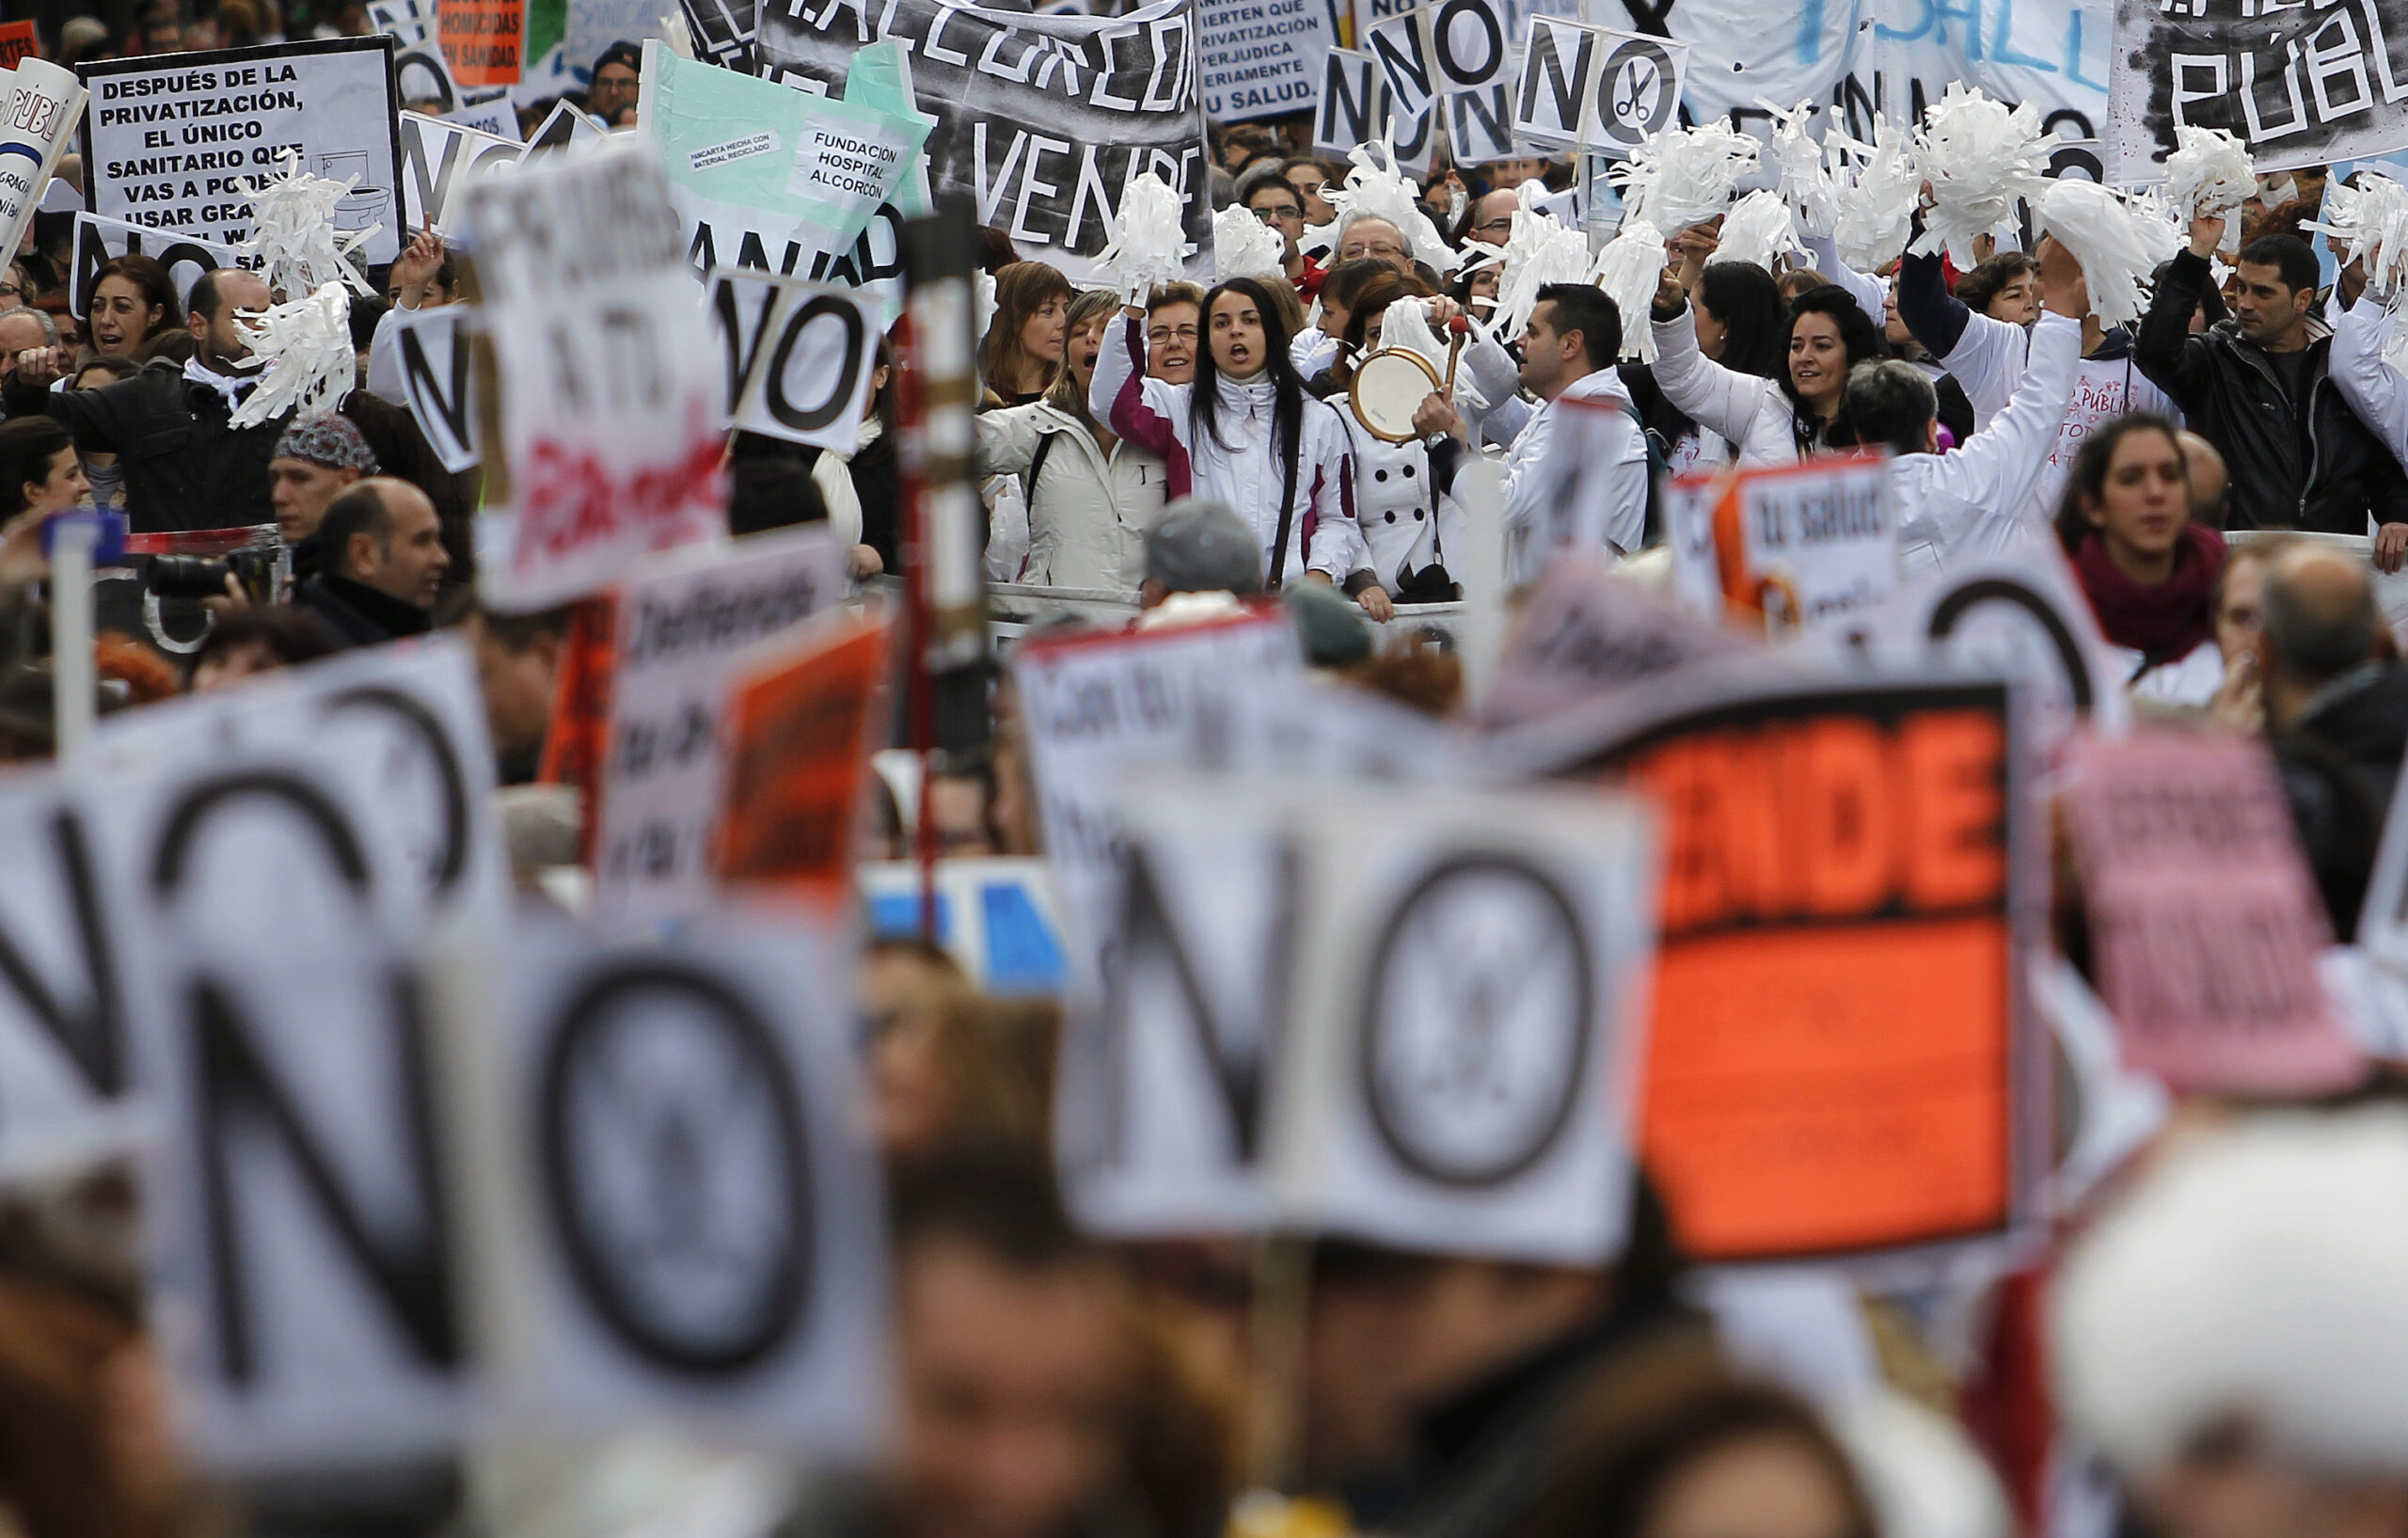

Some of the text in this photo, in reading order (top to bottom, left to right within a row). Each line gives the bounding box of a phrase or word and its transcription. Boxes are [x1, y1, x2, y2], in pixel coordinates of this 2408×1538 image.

[440, 11, 519, 35] HOMICIDAS
[1269, 0, 1305, 16] QUE
[1201, 17, 1319, 48] RIVATIZACIÓN
[1370, 0, 1504, 115] NO
[103, 65, 297, 100] DESPUÉS DE LA
[1203, 59, 1304, 87] ERIAMENTE
[1520, 22, 1675, 145] NO
[100, 89, 304, 126] PRIVATIZACIÓN,
[1205, 80, 1317, 114] U SALUD.
[145, 120, 262, 149] EL ÚNICO
[725, 138, 752, 151] HECHA
[752, 134, 769, 144] CON
[814, 132, 897, 164] FUNDACIÓN
[107, 143, 304, 179] SANITARIO QUE
[727, 143, 769, 160] RECICLADO
[818, 151, 884, 180] HOSPITAL
[124, 182, 174, 203] VAS
[182, 181, 199, 198] A
[810, 169, 883, 199] ALCORCÓN
[200, 203, 255, 223] GRA
[1099, 832, 1597, 1187] NO
[181, 959, 815, 1387] NO
